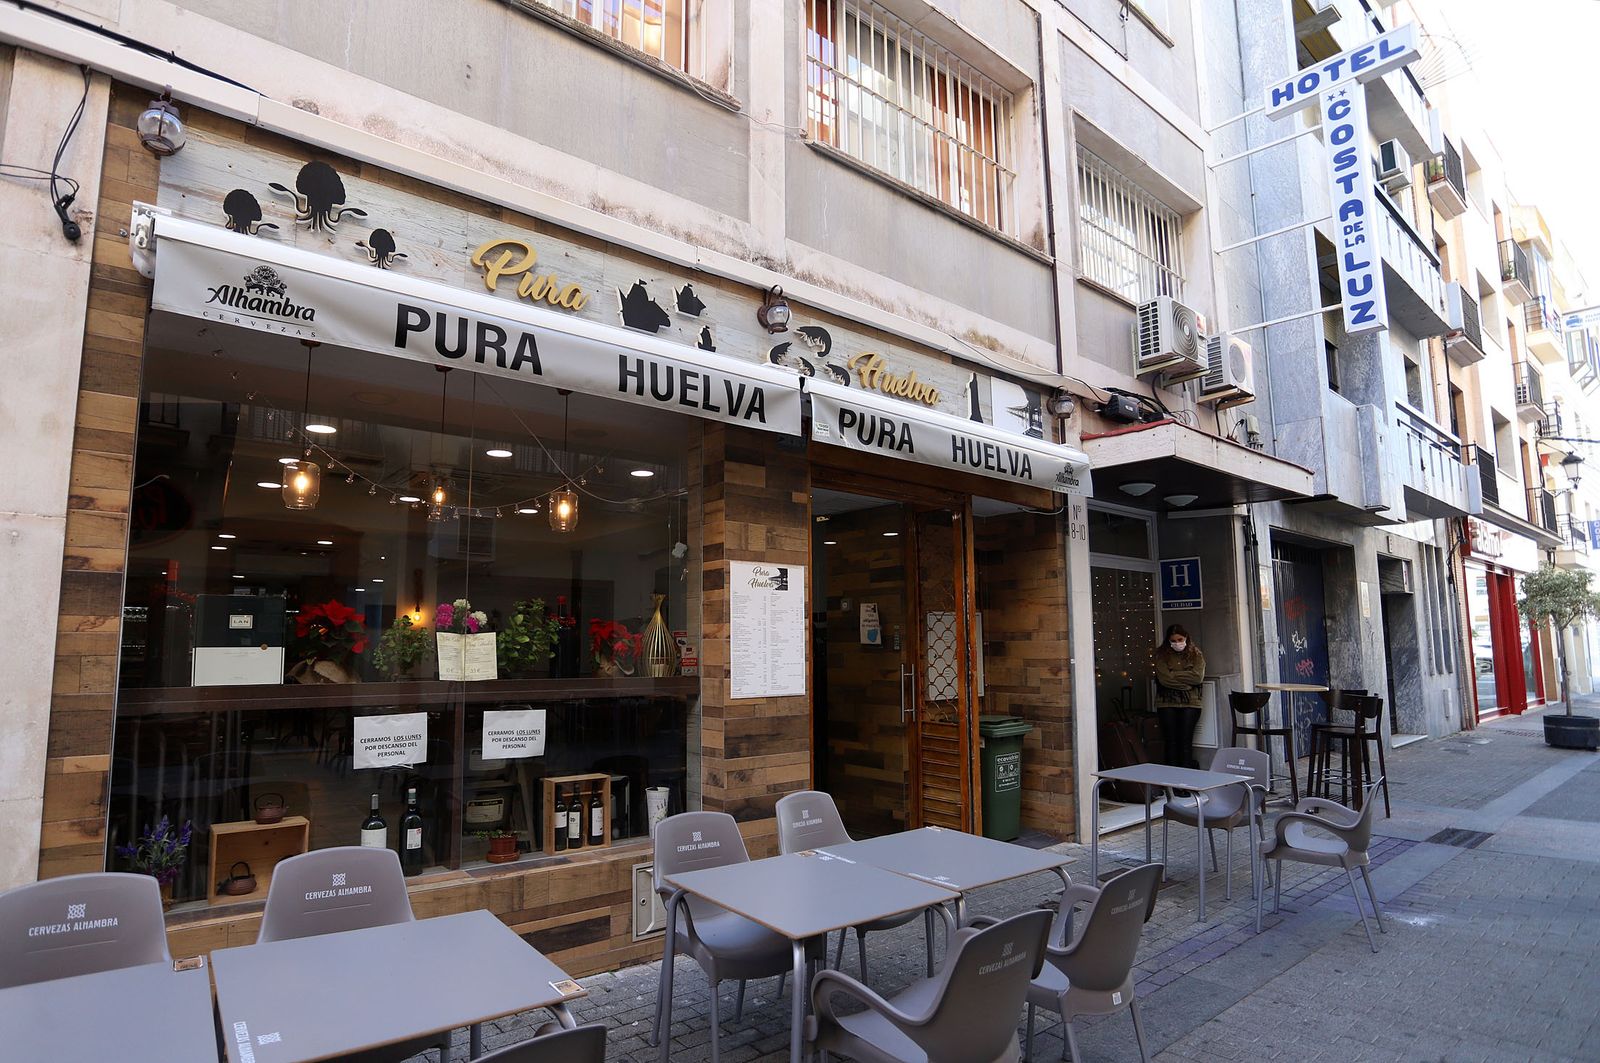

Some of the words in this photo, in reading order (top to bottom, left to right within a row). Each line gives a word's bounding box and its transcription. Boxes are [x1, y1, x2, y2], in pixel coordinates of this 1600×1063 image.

[1271, 38, 1405, 107] HOTEL
[1327, 99, 1364, 222] COSTA
[1343, 221, 1364, 235] DE
[1344, 234, 1365, 248] LA
[470, 239, 591, 312] Pura
[1345, 252, 1376, 325] LUZ
[205, 284, 316, 322] Alhambra
[203, 311, 316, 337] CERVEZAS
[394, 302, 543, 376] PURA
[618, 354, 767, 424] HUELVA
[847, 351, 941, 406] Huelva
[838, 407, 914, 454] PURA
[951, 434, 1033, 480] HUELVA
[1071, 522, 1086, 540] 8-10
[752, 566, 769, 576] Pura
[1169, 563, 1191, 587] H
[360, 736, 391, 744] CERRAMOS
[393, 734, 404, 742] LOS
[405, 733, 422, 741] LUNES
[364, 743, 376, 751] POR
[377, 742, 406, 750] DESCANSO
[377, 750, 406, 758] PERSONAL
[305, 888, 336, 900] CERVEZAS
[338, 885, 372, 897] ALHAMBRA
[28, 922, 71, 937] CERVEZAS
[73, 917, 118, 931] ALHAMBRA
